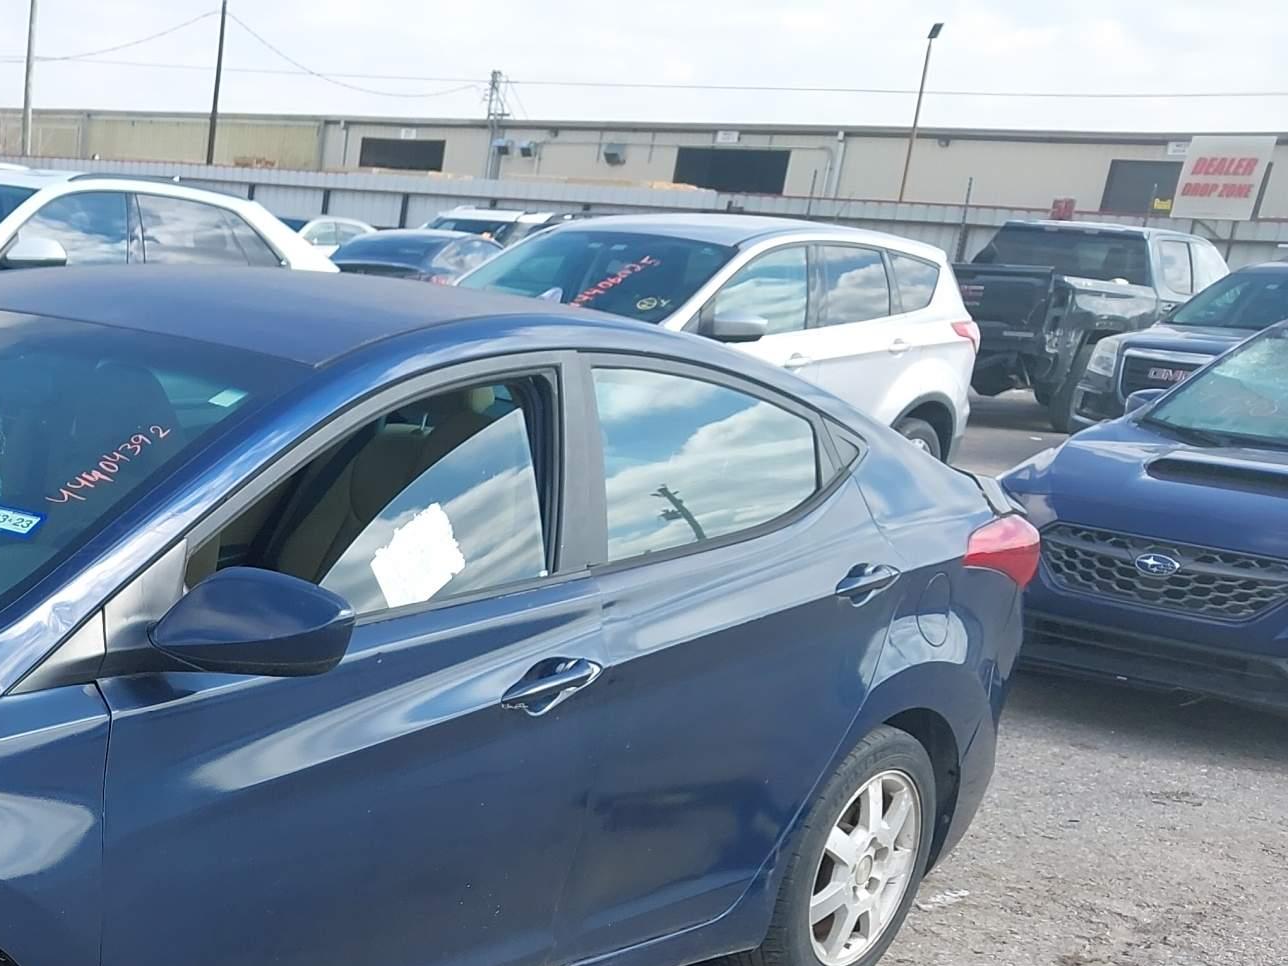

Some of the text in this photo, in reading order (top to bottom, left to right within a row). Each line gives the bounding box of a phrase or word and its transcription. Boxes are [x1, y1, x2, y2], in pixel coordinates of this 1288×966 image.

[1190, 157, 1259, 176] DEALER
[1181, 182, 1254, 198] DROP ZONE
